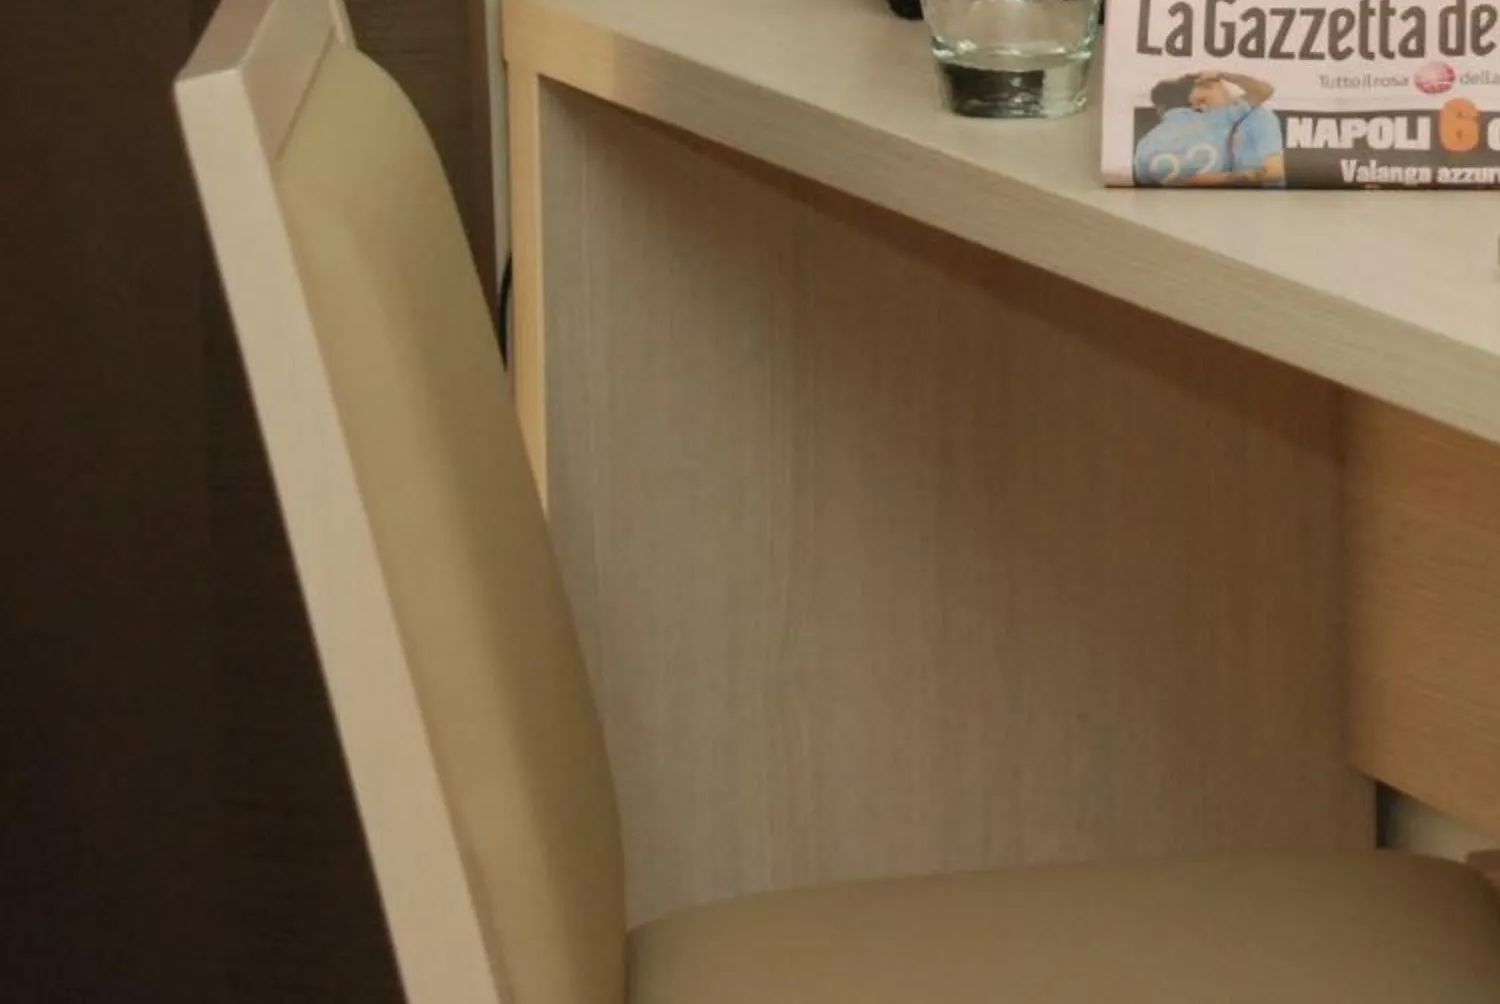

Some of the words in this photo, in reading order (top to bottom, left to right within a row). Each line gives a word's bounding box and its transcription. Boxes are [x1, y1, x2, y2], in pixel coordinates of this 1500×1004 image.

[1459, 69, 1500, 86] della
[1286, 116, 1431, 150] NAPOLI
[1439, 98, 1482, 153] 6
[1340, 158, 1431, 185] Valanga
